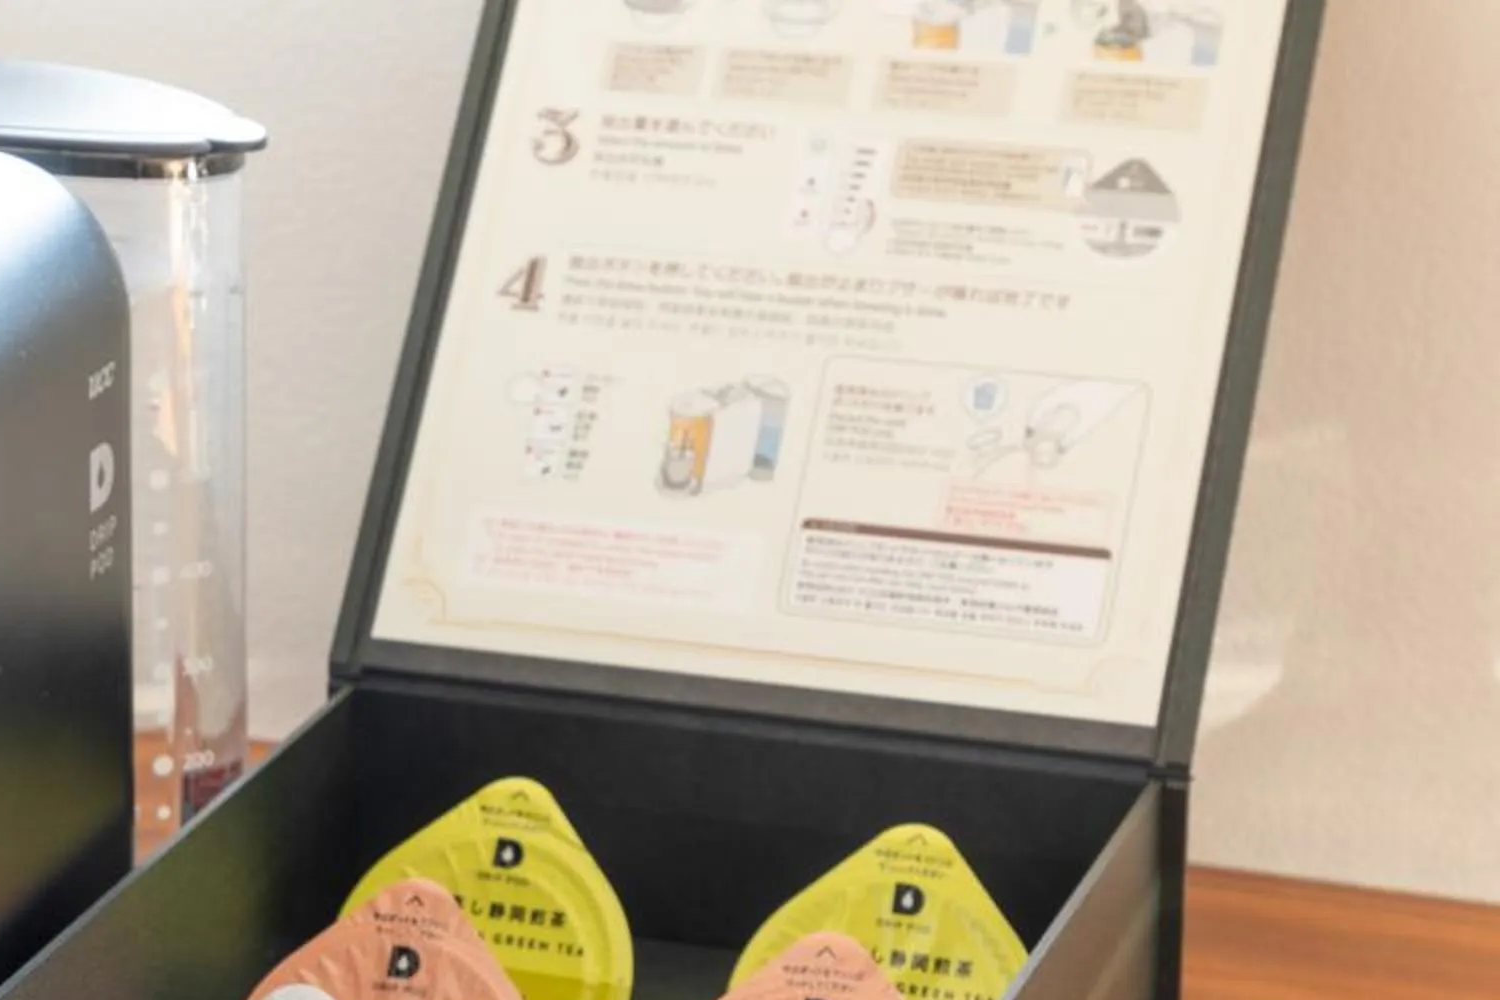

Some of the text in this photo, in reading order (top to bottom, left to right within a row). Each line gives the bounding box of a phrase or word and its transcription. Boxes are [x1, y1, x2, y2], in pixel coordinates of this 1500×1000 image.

[531, 108, 580, 166] 3
[496, 255, 547, 312] 4
[90, 442, 115, 514] D
[492, 836, 524, 869] D
[453, 894, 566, 928] し静岡煎茶
[892, 881, 926, 916] D
[493, 932, 549, 951] GREEN
[557, 942, 584, 957] TEA
[387, 945, 420, 979] D
